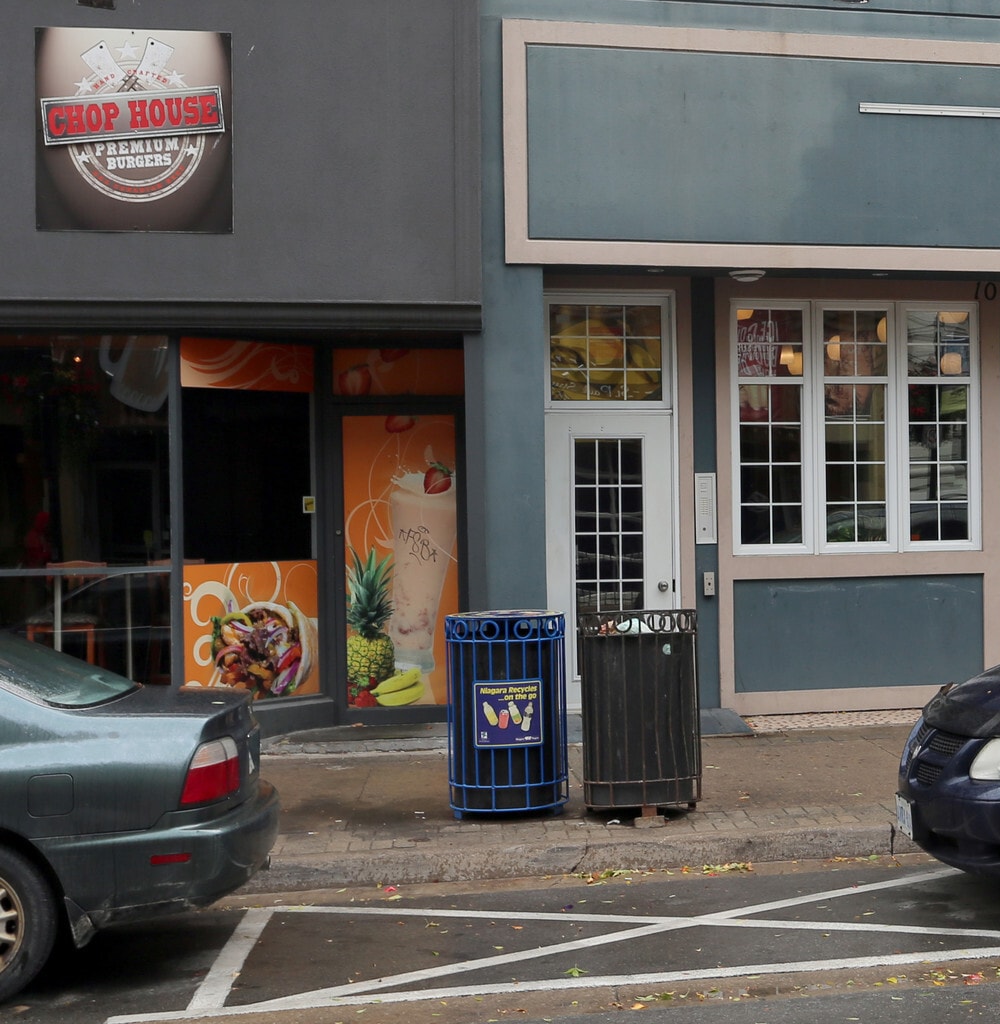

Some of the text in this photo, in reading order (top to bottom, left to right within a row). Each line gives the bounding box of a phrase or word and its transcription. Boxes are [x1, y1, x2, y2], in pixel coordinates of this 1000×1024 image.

[47, 94, 219, 136] CHOP HOUSE
[95, 136, 180, 157] PREMIUM
[106, 152, 173, 170] BURGERS
[480, 685, 538, 695] Niagara Recycles
